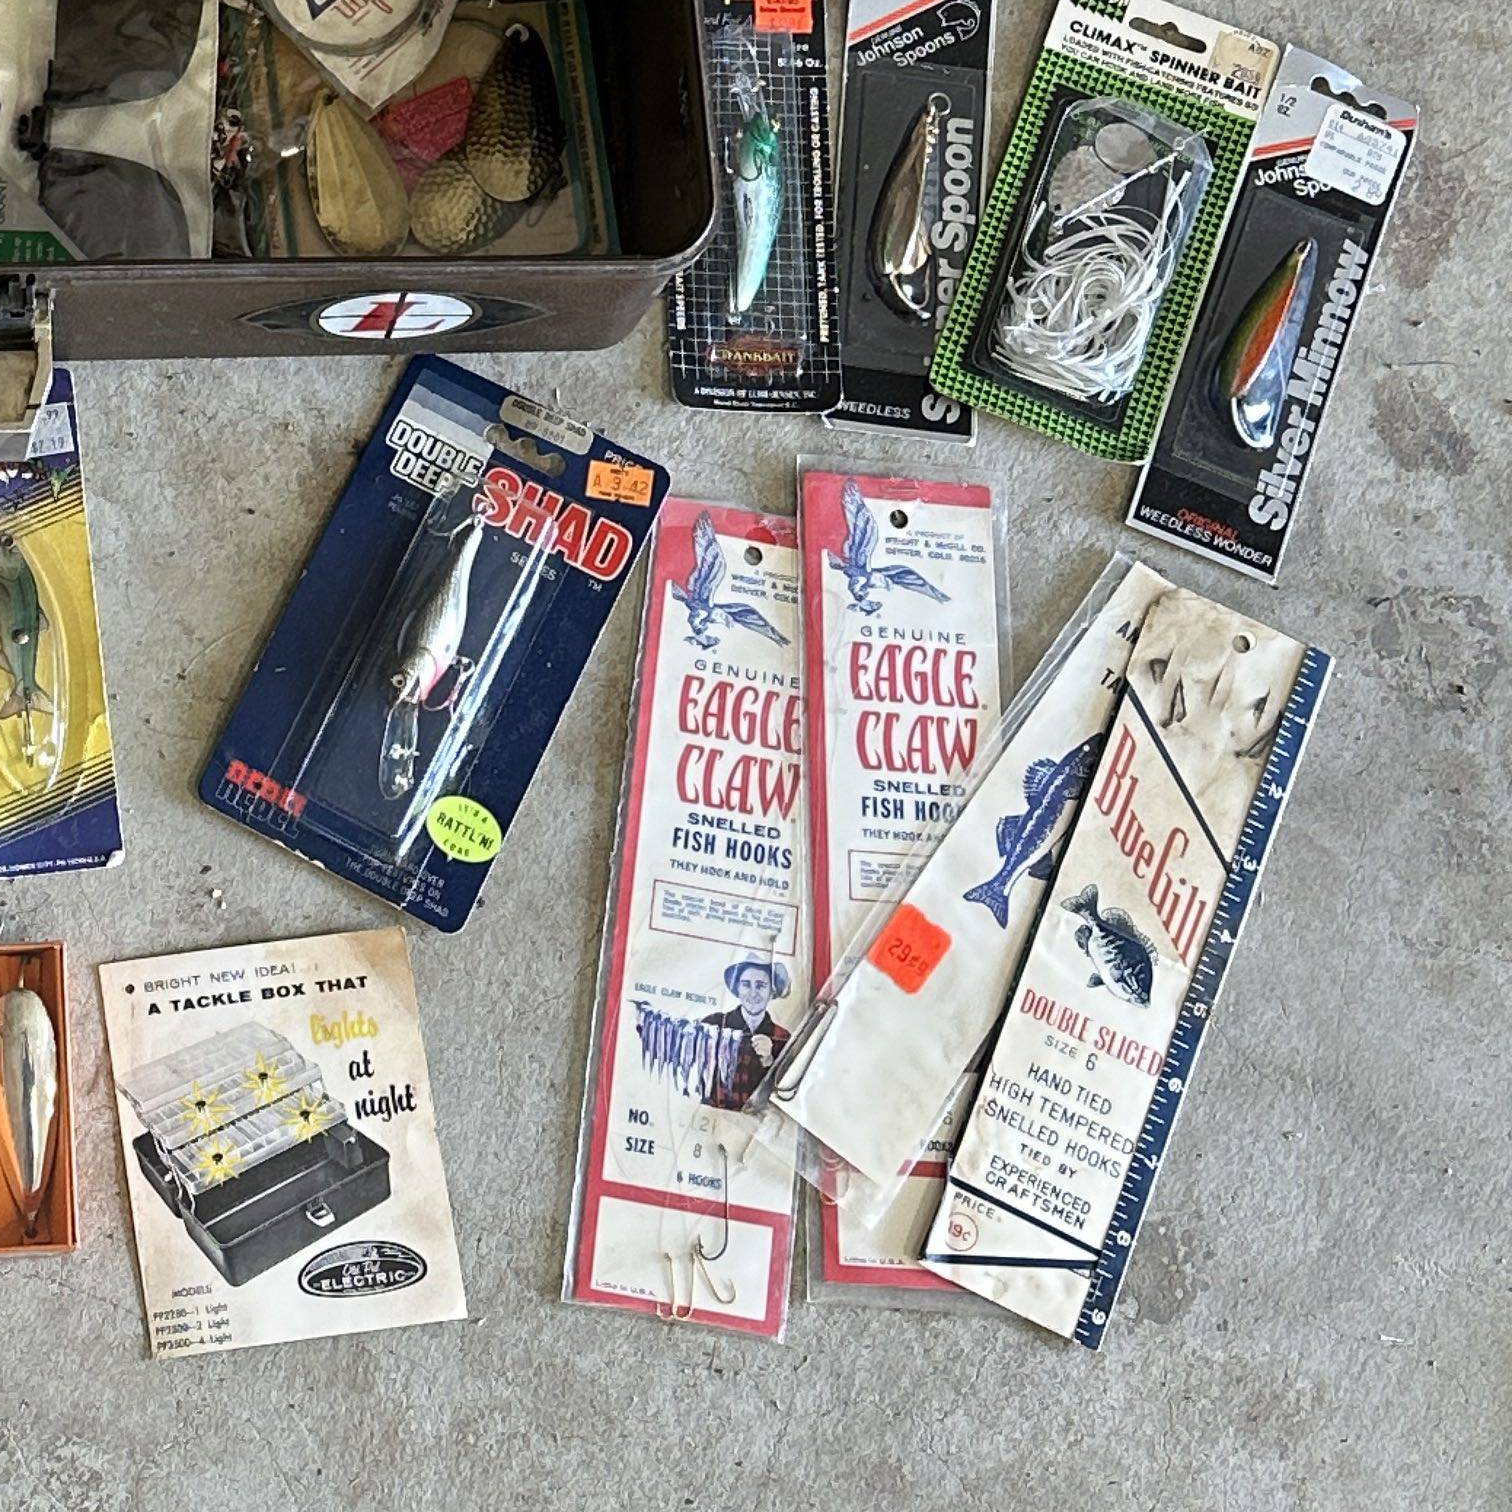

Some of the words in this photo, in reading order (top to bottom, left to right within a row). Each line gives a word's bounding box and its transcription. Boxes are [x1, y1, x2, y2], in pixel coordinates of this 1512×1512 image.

[857, 26, 924, 67] Johnson
[892, 30, 956, 68] Spoons
[1060, 43, 1079, 57] YOU
[1079, 50, 1100, 64] CAN
[1101, 47, 1125, 63] WITH
[1148, 50, 1221, 86] SPINNER
[1222, 74, 1263, 100] BAIT
[809, 86, 821, 131] CASTING
[811, 132, 821, 148] OR
[931, 116, 978, 255] Spoon
[814, 199, 824, 220] FOR
[1247, 403, 1317, 531] Silver
[1287, 238, 1369, 409] Minnow
[838, 399, 912, 419] WEEDLESS
[390, 421, 483, 483] DOUBLE
[395, 449, 456, 491] DEEP
[472, 466, 634, 582] SHAD
[1139, 504, 1212, 545] WEEDLESS
[1212, 534, 1274, 568] WONDER
[1176, 507, 1238, 541] ORIGINAL
[509, 551, 557, 581] SEES
[859, 625, 967, 646] GENUINE
[693, 659, 800, 690] GENUINE
[848, 641, 978, 710] EAGLE
[678, 674, 803, 756] EAGLE
[855, 710, 979, 778] CLAW
[675, 743, 802, 824] CLAW
[872, 778, 966, 797] SNELLED
[687, 812, 782, 840] SNELLED
[861, 796, 904, 821] FISH
[672, 826, 718, 857] FISH
[725, 838, 793, 870] HOOKS
[861, 828, 890, 840] THEY
[669, 858, 698, 873] THEY
[700, 866, 731, 881] HOOK
[733, 871, 757, 885] AND
[758, 877, 789, 891] HOLD
[143, 974, 201, 993] BRIGHT
[209, 969, 246, 984] NEW
[254, 963, 296, 978] IDEA!
[147, 1002, 161, 1016] A
[169, 990, 253, 1013] TACKLE
[260, 982, 306, 1001] BOX
[314, 975, 368, 993] THAT
[309, 1009, 380, 1049] lights
[1019, 987, 1094, 1044] DOUBLE
[1094, 1024, 1164, 1076] SLICED
[348, 1049, 375, 1082] at
[1043, 1034, 1077, 1059] SIZE
[1084, 1053, 1098, 1073] 6
[354, 1084, 418, 1123] night
[1027, 1062, 1072, 1096] HAND
[1076, 1085, 1112, 1116] TIED
[1166, 1078, 1184, 1093] 6
[989, 1072, 1033, 1106] HIGH
[1040, 1096, 1136, 1156] TEMPERED
[625, 1136, 656, 1156] SIZE
[692, 1143, 703, 1159] 8
[984, 1100, 1059, 1148] SNELLED
[1065, 1138, 1122, 1180] HOOKS
[1019, 1142, 1051, 1167] TIED
[1057, 1162, 1077, 1179] BY
[688, 1171, 723, 1190] HOOKS
[989, 1154, 1092, 1216] EXPERIENCED
[953, 1191, 995, 1220] PRICE
[984, 1172, 1086, 1231] CRAFTSMEN
[1115, 1231, 1132, 1247] 8
[319, 1268, 407, 1291] ELECTRIC
[1091, 1311, 1108, 1326] 9
